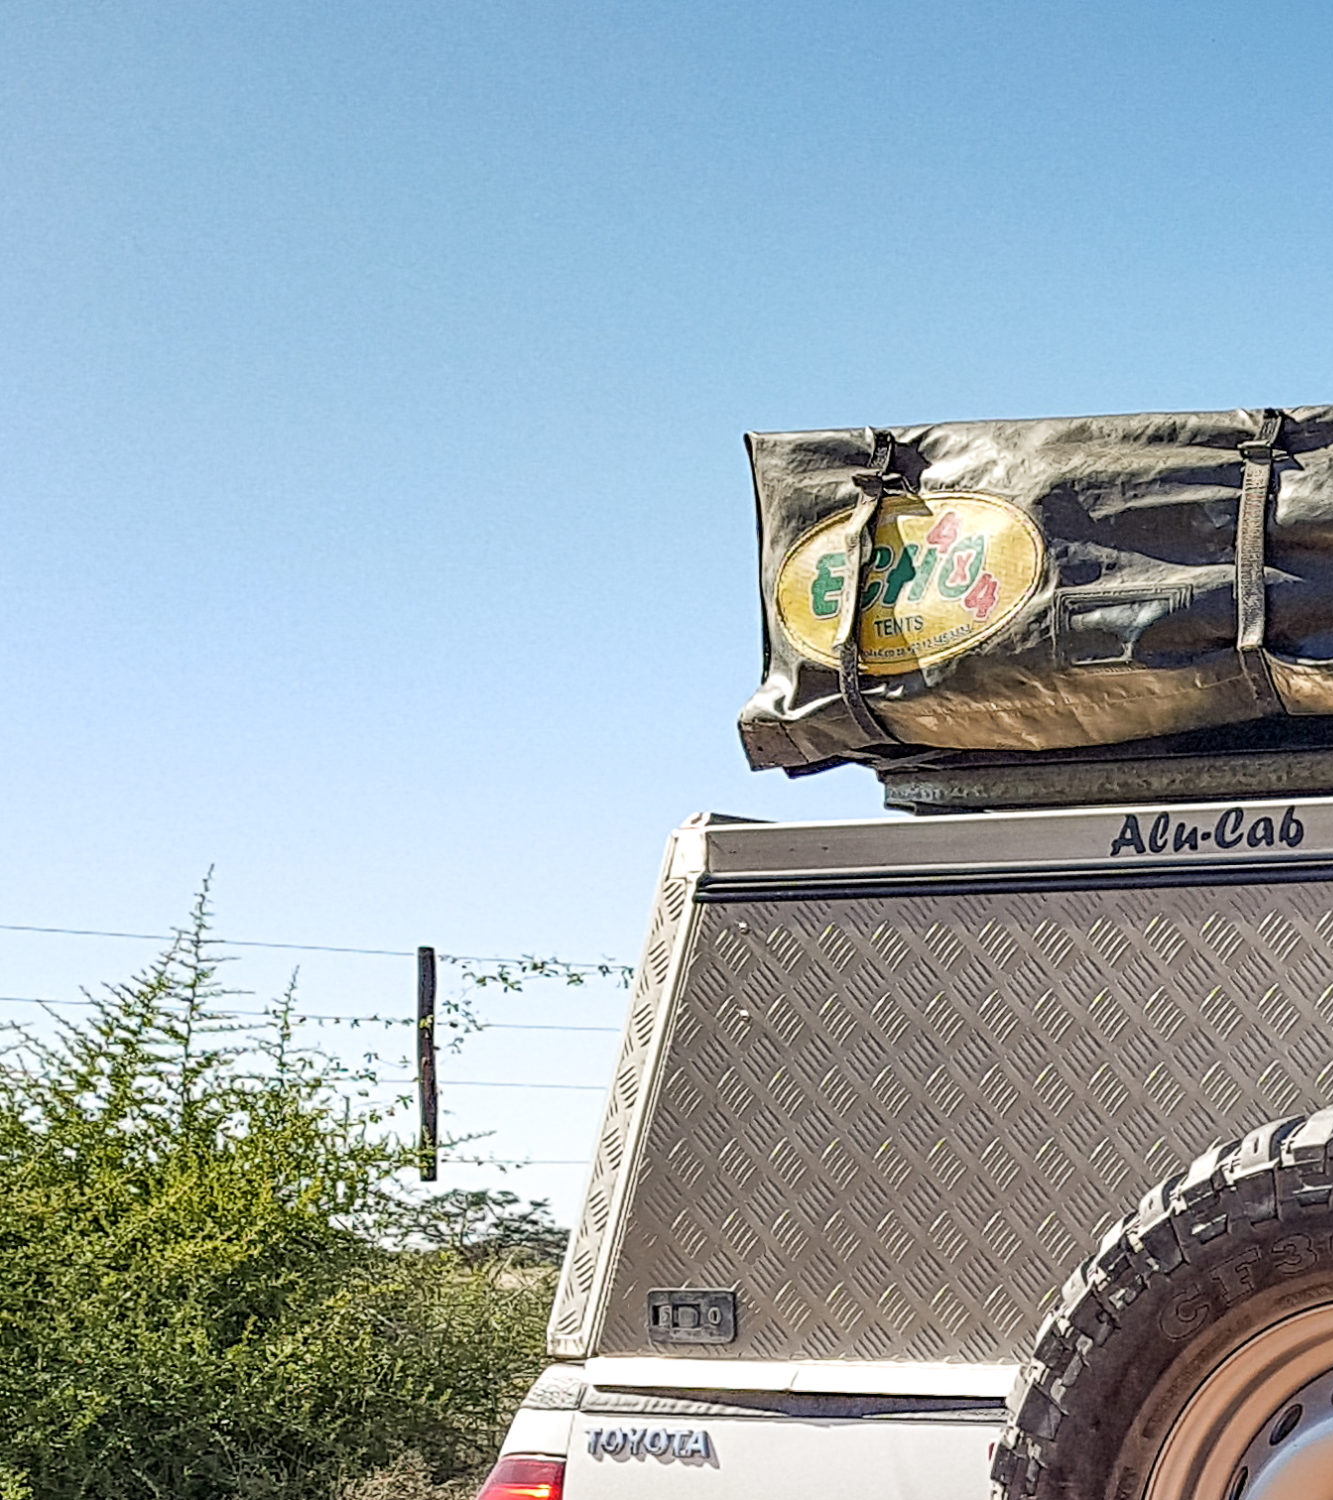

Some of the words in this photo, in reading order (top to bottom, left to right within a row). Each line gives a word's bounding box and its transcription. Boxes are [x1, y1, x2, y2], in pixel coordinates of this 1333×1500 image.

[874, 616, 924, 638] TENTS
[1110, 805, 1304, 856] Alu-Cab
[586, 1427, 711, 1459] TOYOTA
